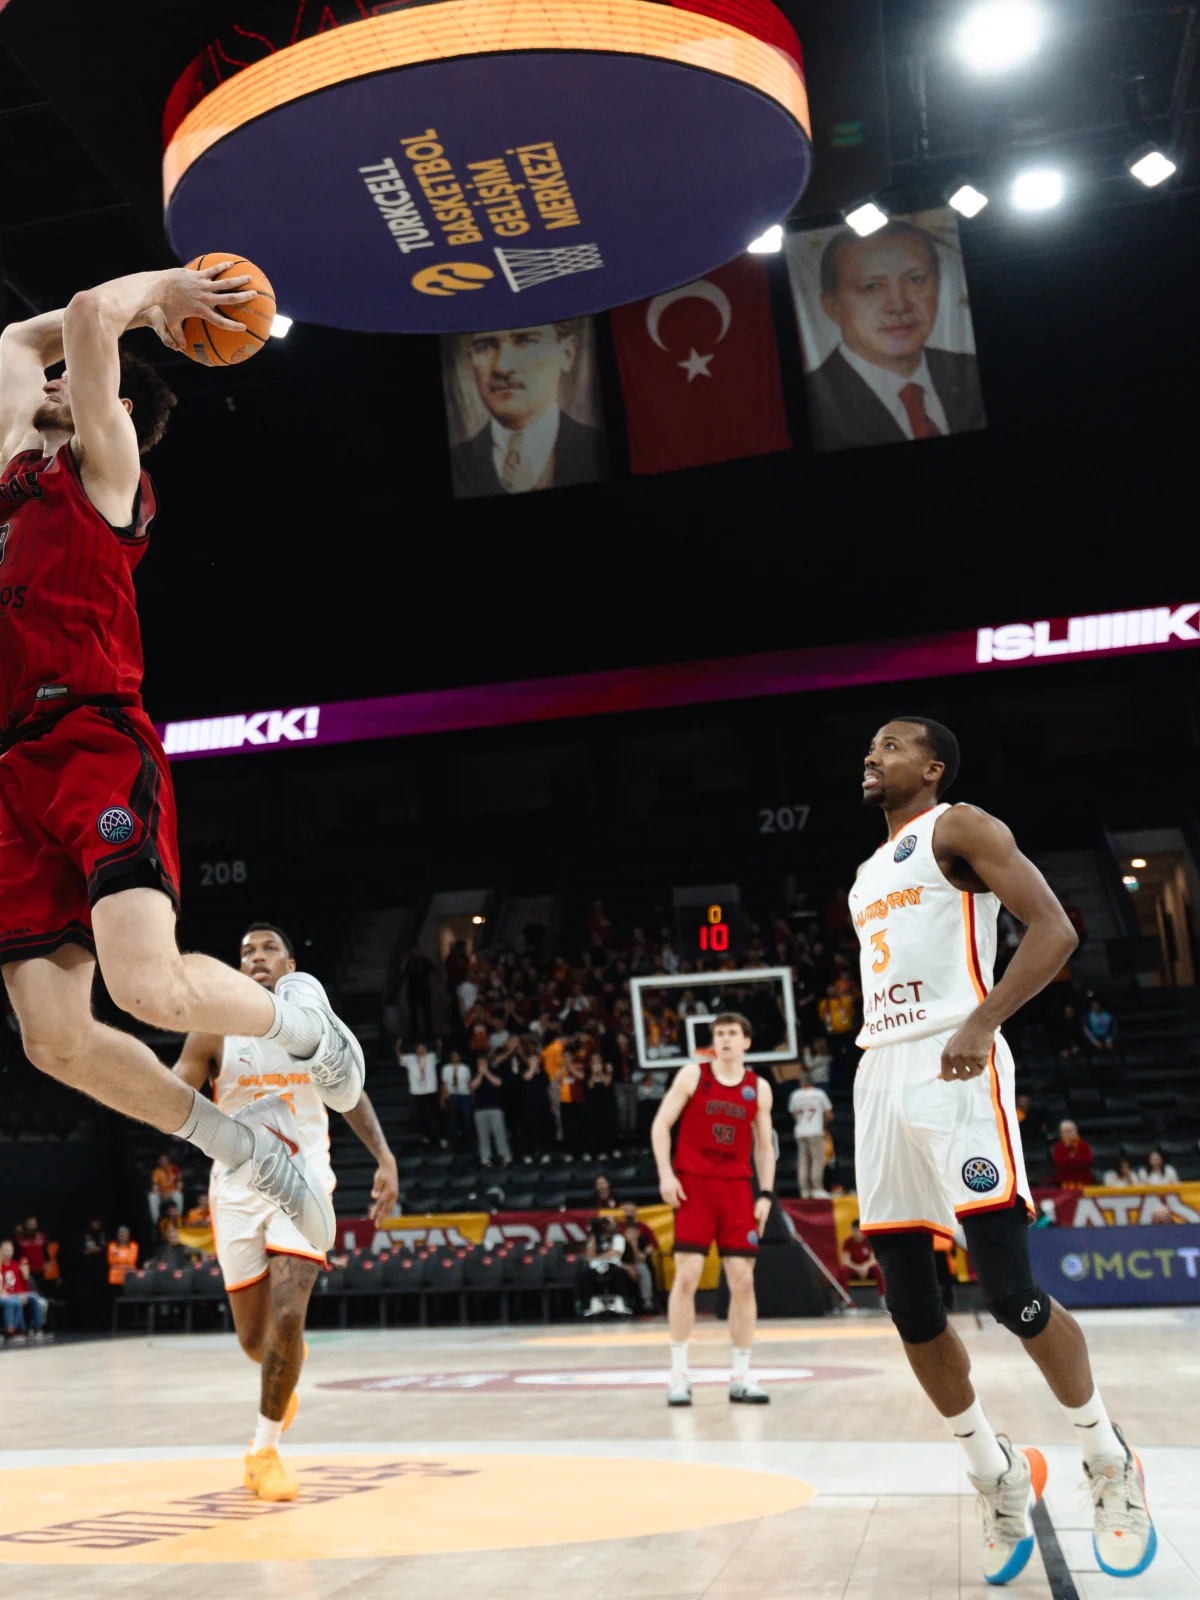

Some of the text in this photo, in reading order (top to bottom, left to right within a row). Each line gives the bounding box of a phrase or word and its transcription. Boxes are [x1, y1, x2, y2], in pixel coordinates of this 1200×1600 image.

[399, 128, 484, 246] BASKETBOL
[465, 158, 531, 237] GELİŞİM
[505, 142, 581, 230] MERKEZİ
[357, 157, 435, 254] TURKCELL
[757, 805, 811, 834] 207
[199, 860, 248, 886] 208
[708, 904, 722, 924] 0
[699, 923, 729, 951] 10
[870, 928, 891, 974] 3
[874, 980, 923, 1012] MCT
[865, 1007, 927, 1035] echnic
[712, 1123, 735, 1145] 43
